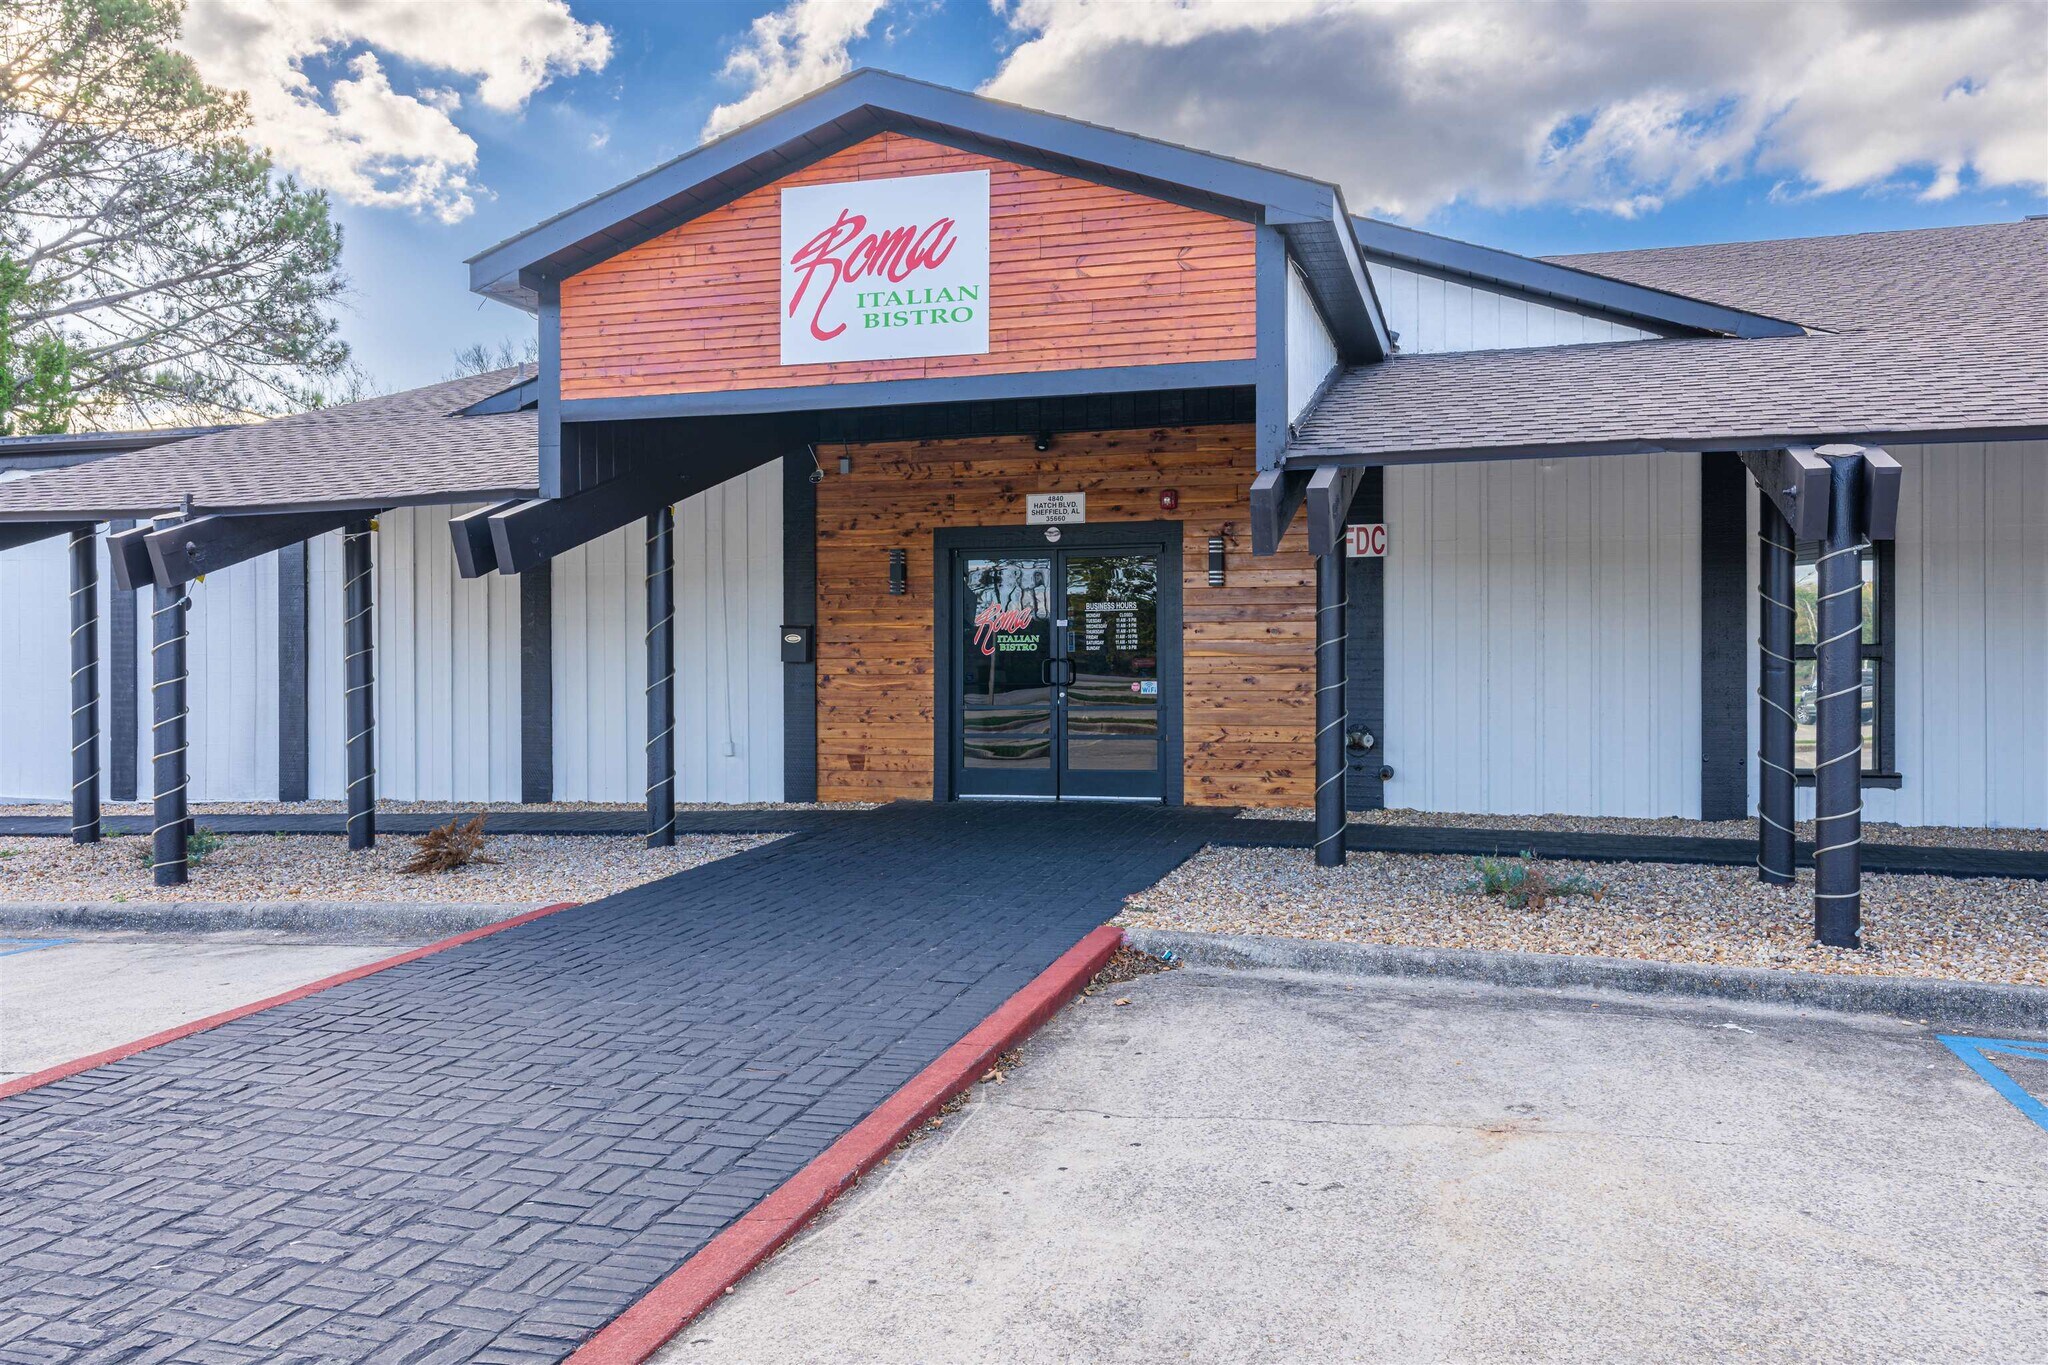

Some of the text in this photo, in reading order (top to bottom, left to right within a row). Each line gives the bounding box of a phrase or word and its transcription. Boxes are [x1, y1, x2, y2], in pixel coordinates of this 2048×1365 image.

[789, 208, 957, 341] Roma
[856, 284, 980, 309] ITALIAN
[863, 306, 974, 329] BISTRO
[974, 601, 1032, 656] Roma
